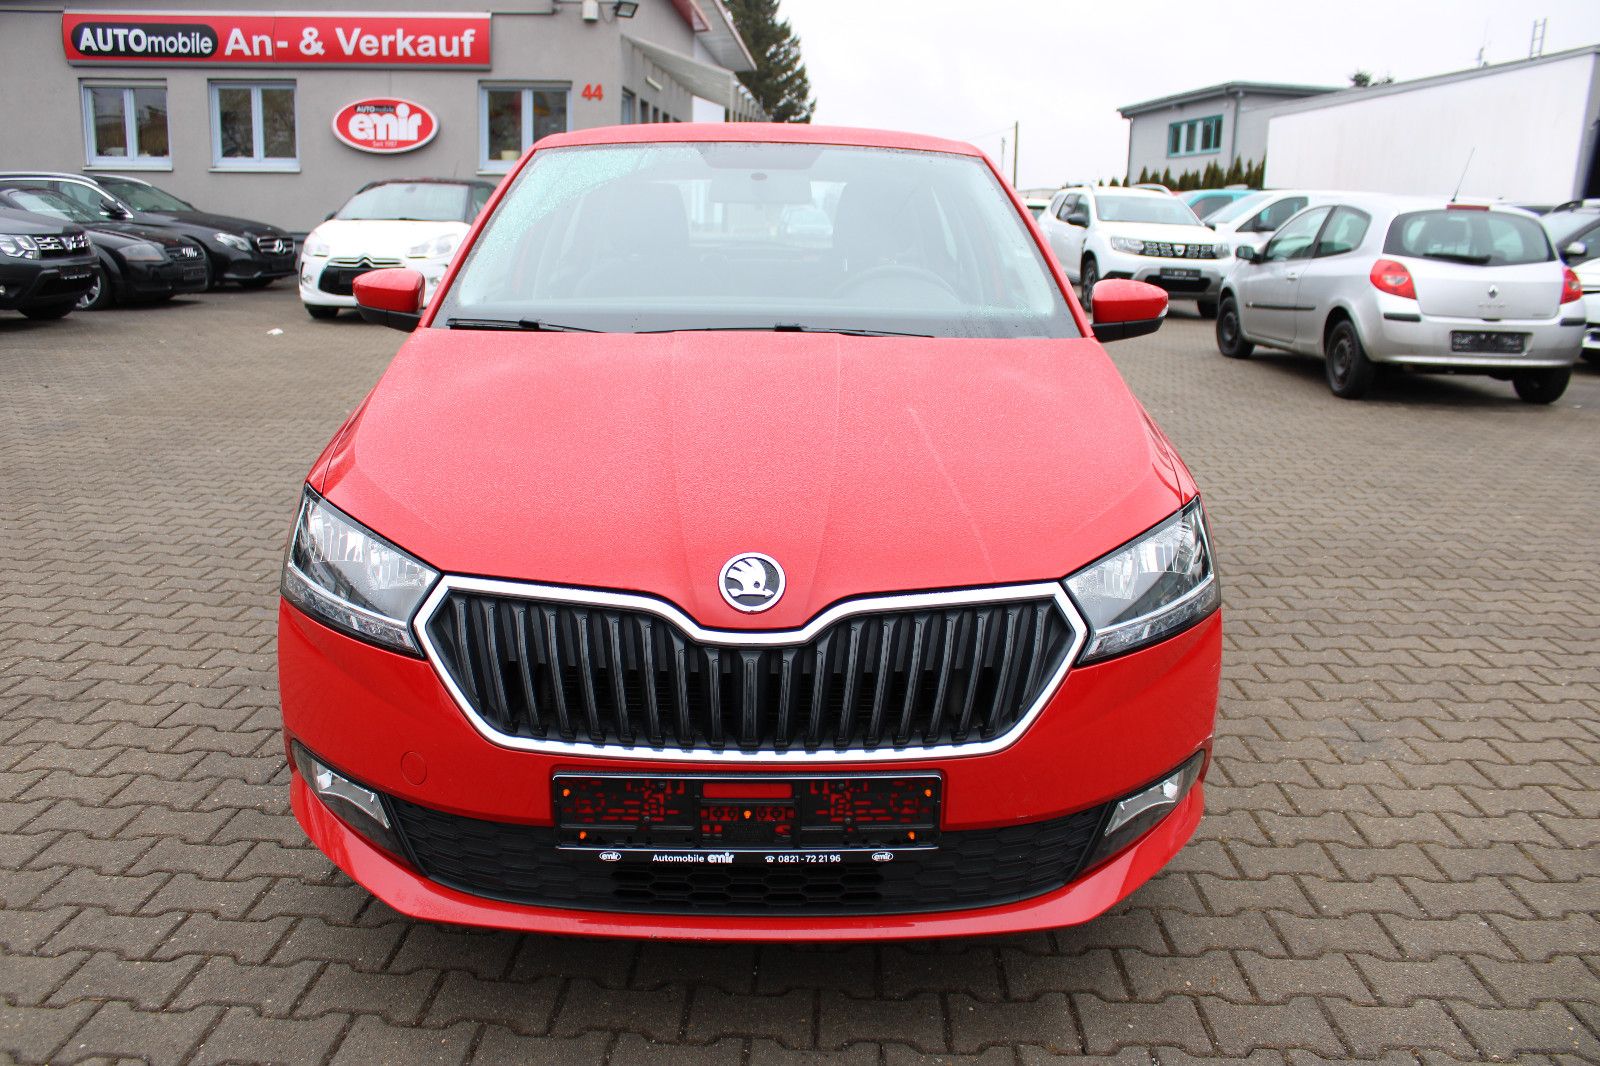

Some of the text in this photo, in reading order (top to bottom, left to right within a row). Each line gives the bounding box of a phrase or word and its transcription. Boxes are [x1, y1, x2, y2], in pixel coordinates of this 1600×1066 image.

[79, 26, 476, 57] AUTOmobile An- & Verkauf
[581, 82, 603, 101] 44
[348, 103, 422, 141] emir
[601, 852, 619, 861] emir
[652, 852, 735, 864] Automobile emir
